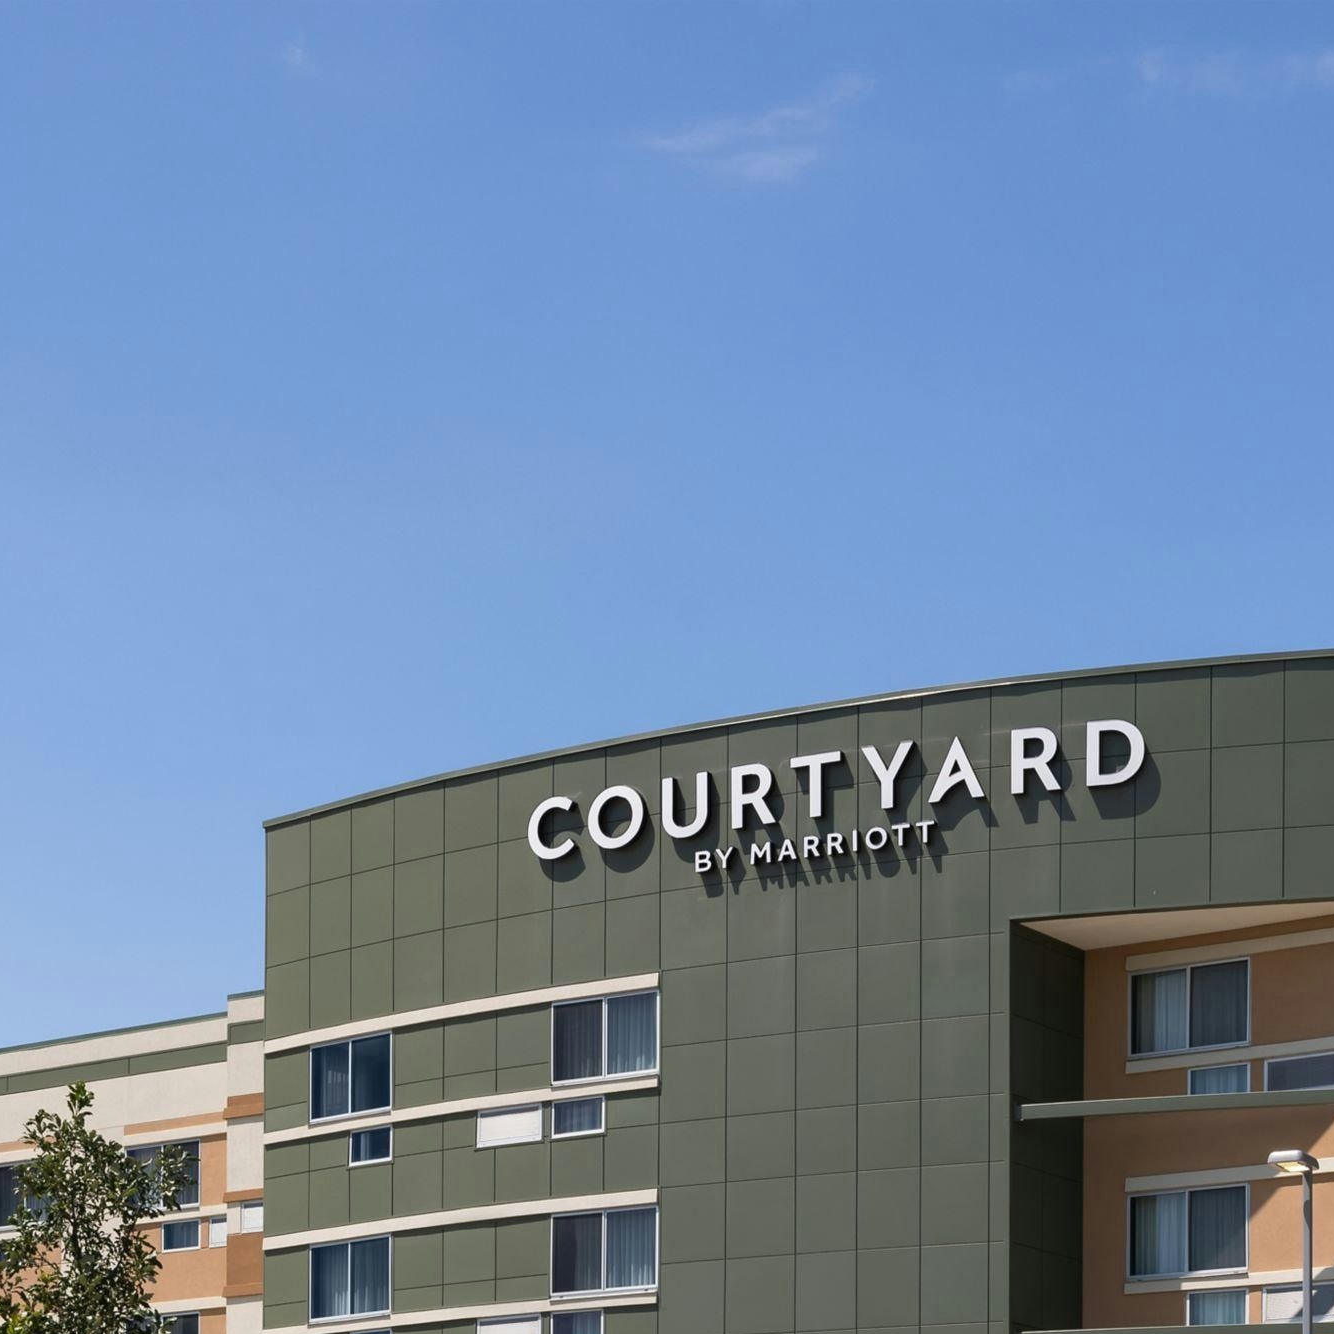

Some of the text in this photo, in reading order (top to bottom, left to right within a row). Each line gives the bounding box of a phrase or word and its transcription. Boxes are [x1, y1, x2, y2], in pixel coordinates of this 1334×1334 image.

[527, 718, 1146, 861] COURTYARD
[694, 820, 936, 874] BY MARRIOTT
